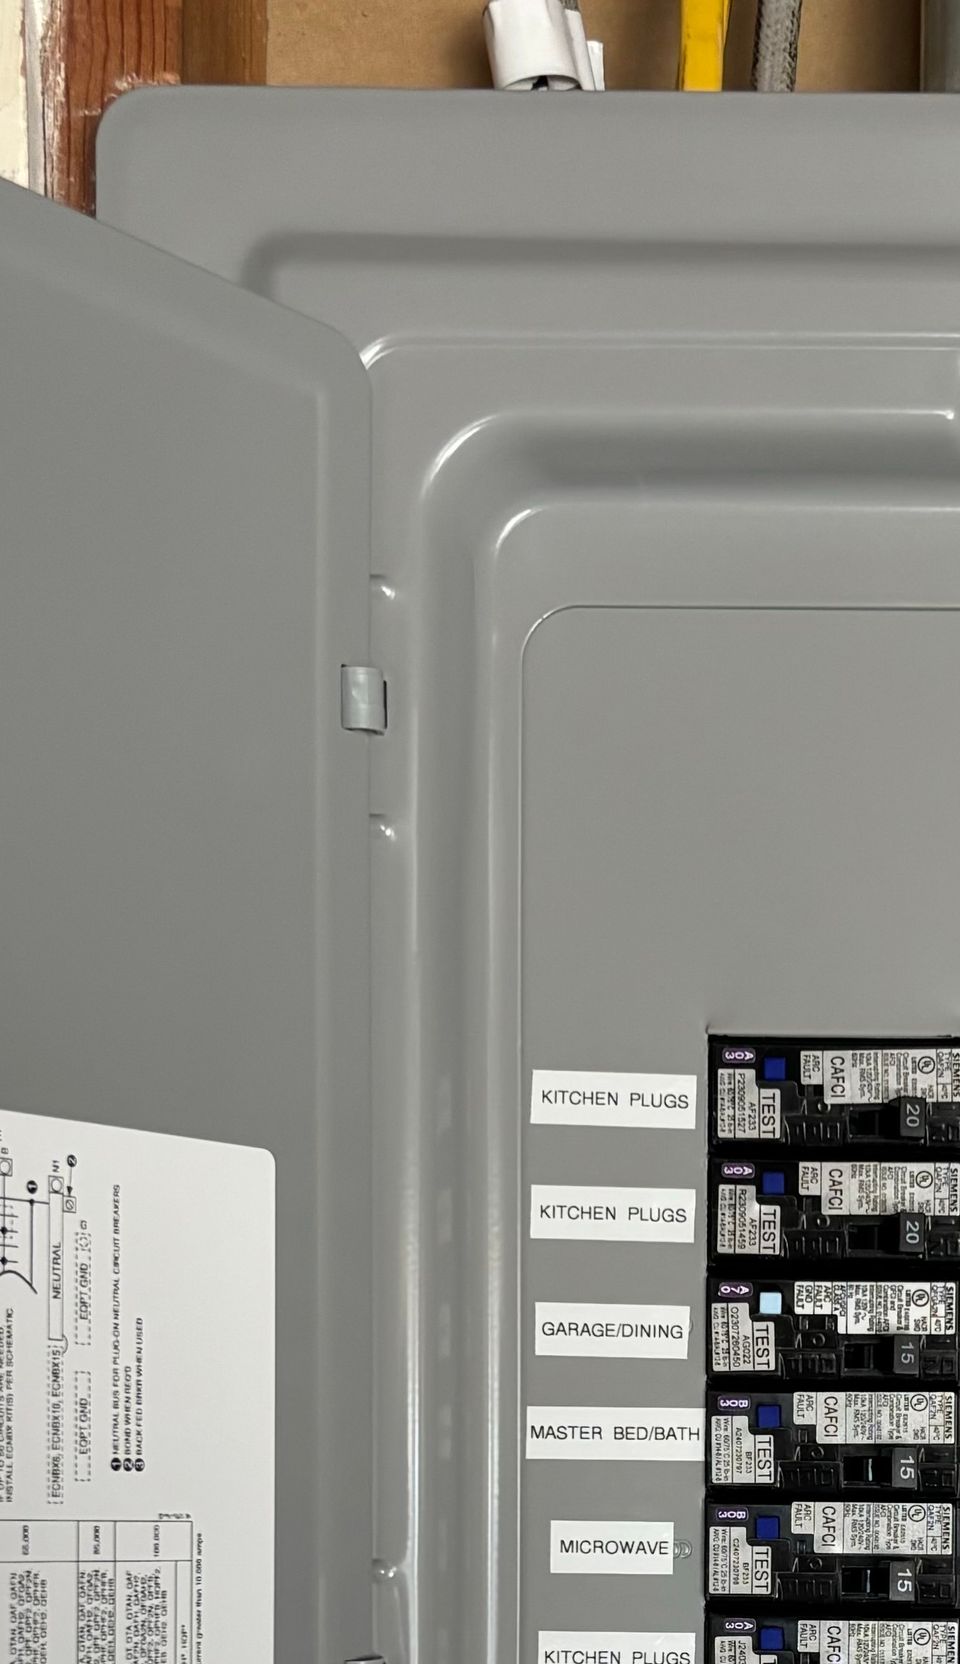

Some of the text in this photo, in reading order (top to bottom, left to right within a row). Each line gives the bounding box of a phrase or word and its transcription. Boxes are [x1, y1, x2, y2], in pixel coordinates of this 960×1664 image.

[831, 1056, 845, 1098] CAFCI
[952, 1052, 960, 1097] SIEMENS
[541, 1090, 689, 1110] KITCHEN PLUGS
[762, 1092, 776, 1138] TEST
[906, 1104, 920, 1127] 20
[828, 1168, 843, 1210] CAFCI
[950, 1168, 958, 1213] SIEMENS
[540, 1205, 687, 1224] KITCHEN PLUGS
[763, 1209, 776, 1253] TEST
[906, 1220, 920, 1244] 20
[52, 1242, 61, 1300] NEUTRAL
[79, 1263, 88, 1320] EQPT GND
[796, 1285, 804, 1309] FAULT
[805, 1285, 813, 1303] GND
[945, 1286, 954, 1331] SIEMENS
[542, 1322, 683, 1339] GARAGE/DINING
[743, 1335, 751, 1364] AG022
[756, 1324, 770, 1369] TEST
[901, 1342, 914, 1364] 15
[52, 1350, 61, 1397] ECNBX15
[796, 1394, 805, 1418] FAULT
[824, 1396, 838, 1437] CAFCI
[79, 1398, 88, 1455] EQPT GND
[530, 1425, 700, 1442] MASTER BED/BATH
[757, 1437, 771, 1481] TEST
[900, 1455, 914, 1479] 15
[794, 1503, 803, 1528] FAULT
[804, 1504, 812, 1521] ARC
[821, 1506, 836, 1547] CAFCI
[942, 1506, 950, 1550] SIEMENS
[560, 1539, 669, 1556] MICROWAVE
[755, 1548, 769, 1592] TEST
[897, 1568, 912, 1592] 15
[800, 1623, 808, 1648] FAULT
[808, 1624, 816, 1641] ARC
[544, 1650, 621, 1664] KITCHEN
